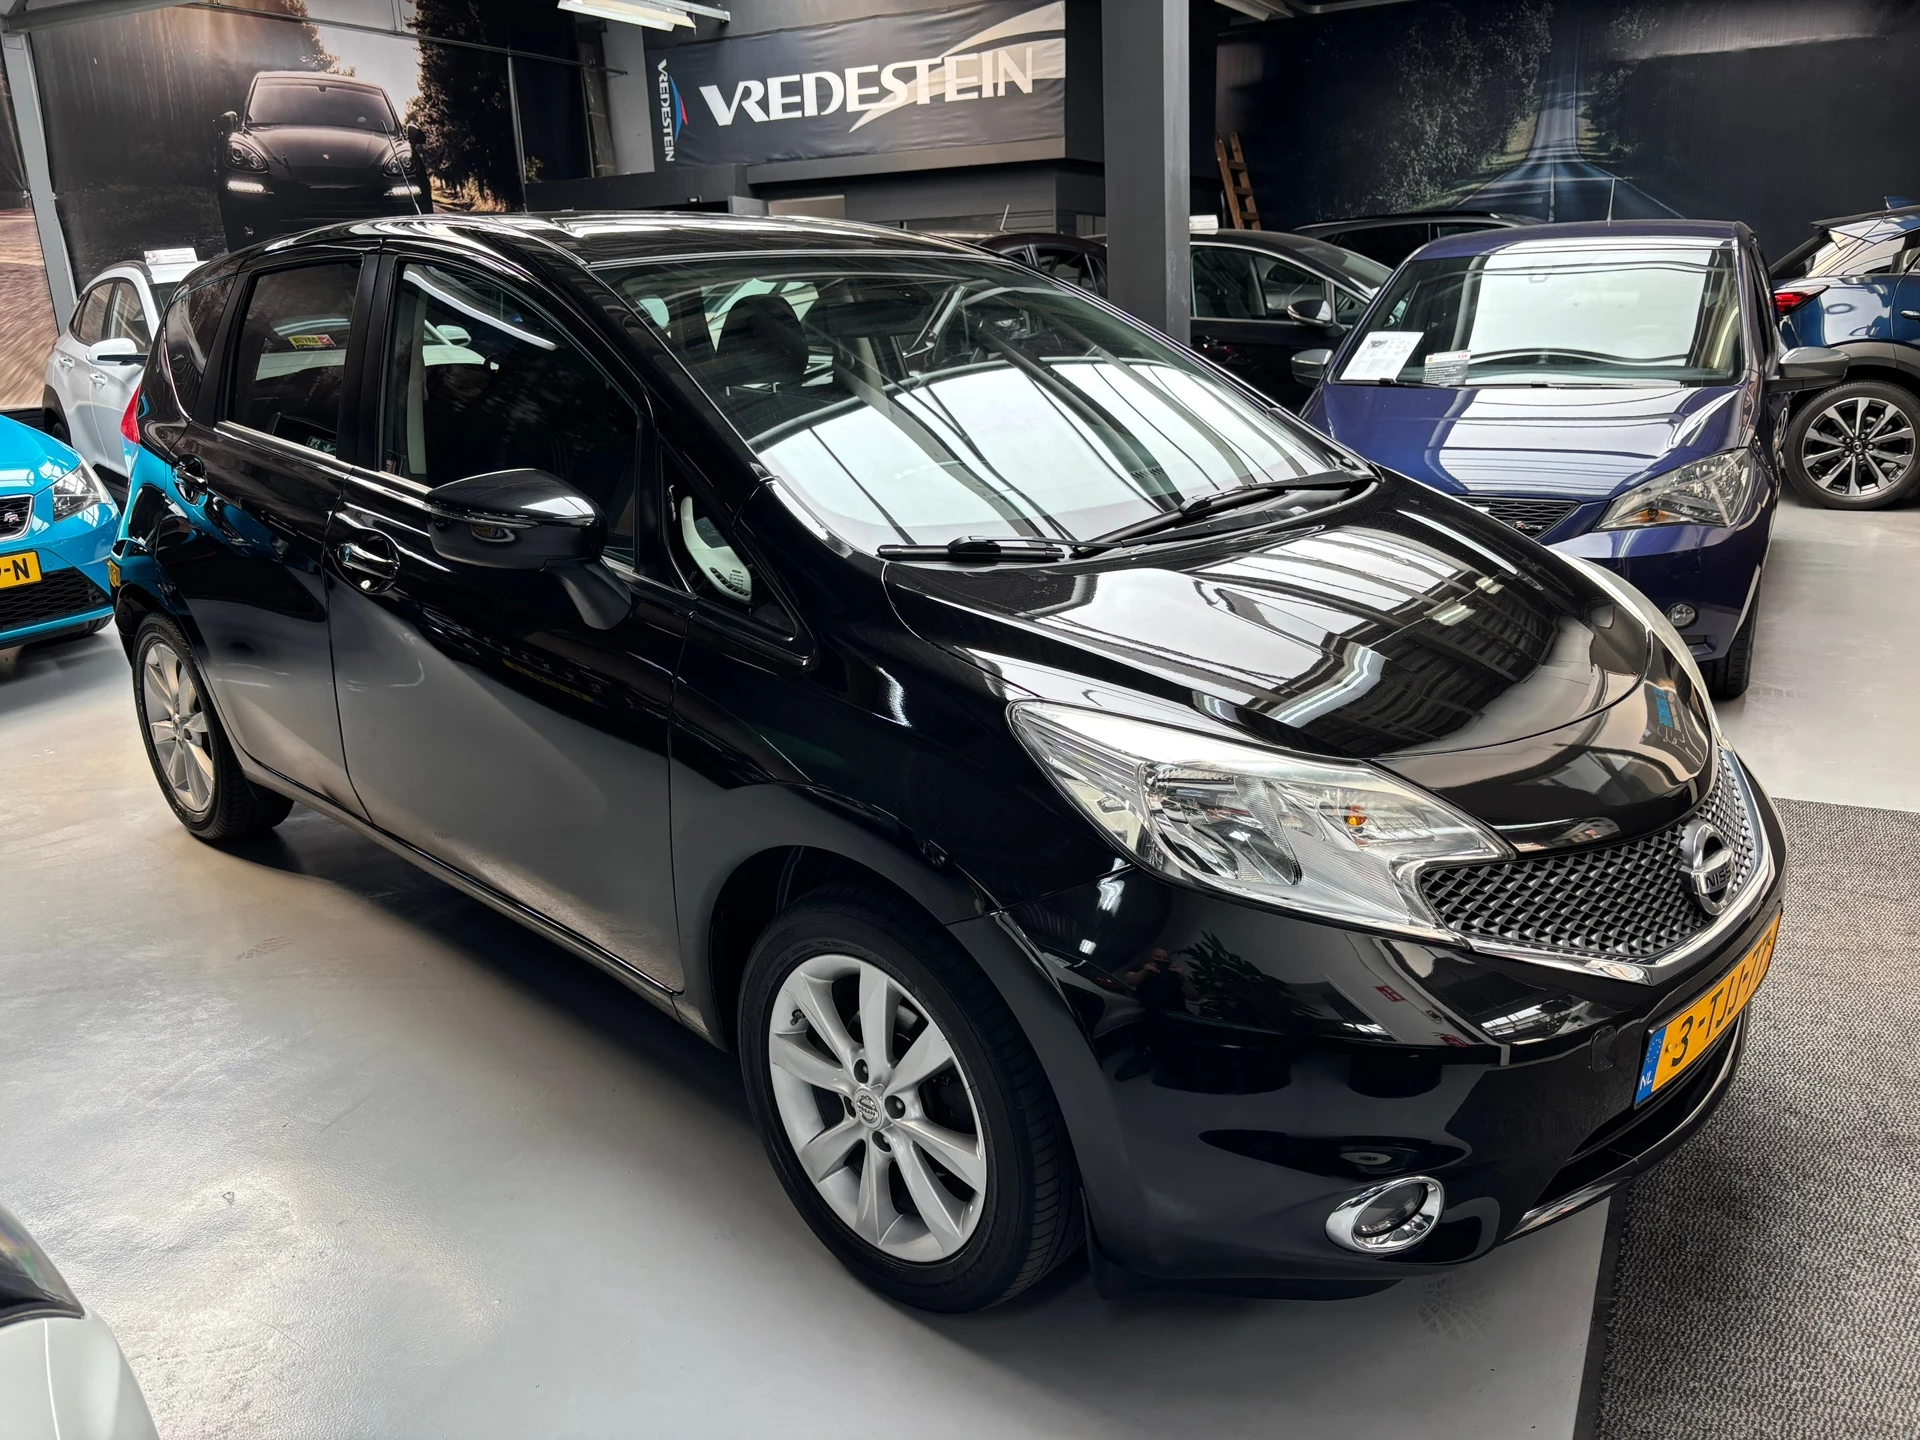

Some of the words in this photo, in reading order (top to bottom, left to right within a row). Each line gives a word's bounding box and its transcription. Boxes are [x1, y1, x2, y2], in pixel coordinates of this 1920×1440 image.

[700, 47, 1033, 128] VREDESTEIN
[658, 59, 675, 162] VREDESTEIN
[0, 558, 30, 581] -N
[1705, 865, 1731, 890] NISS
[1639, 1071, 1653, 1091] NL
